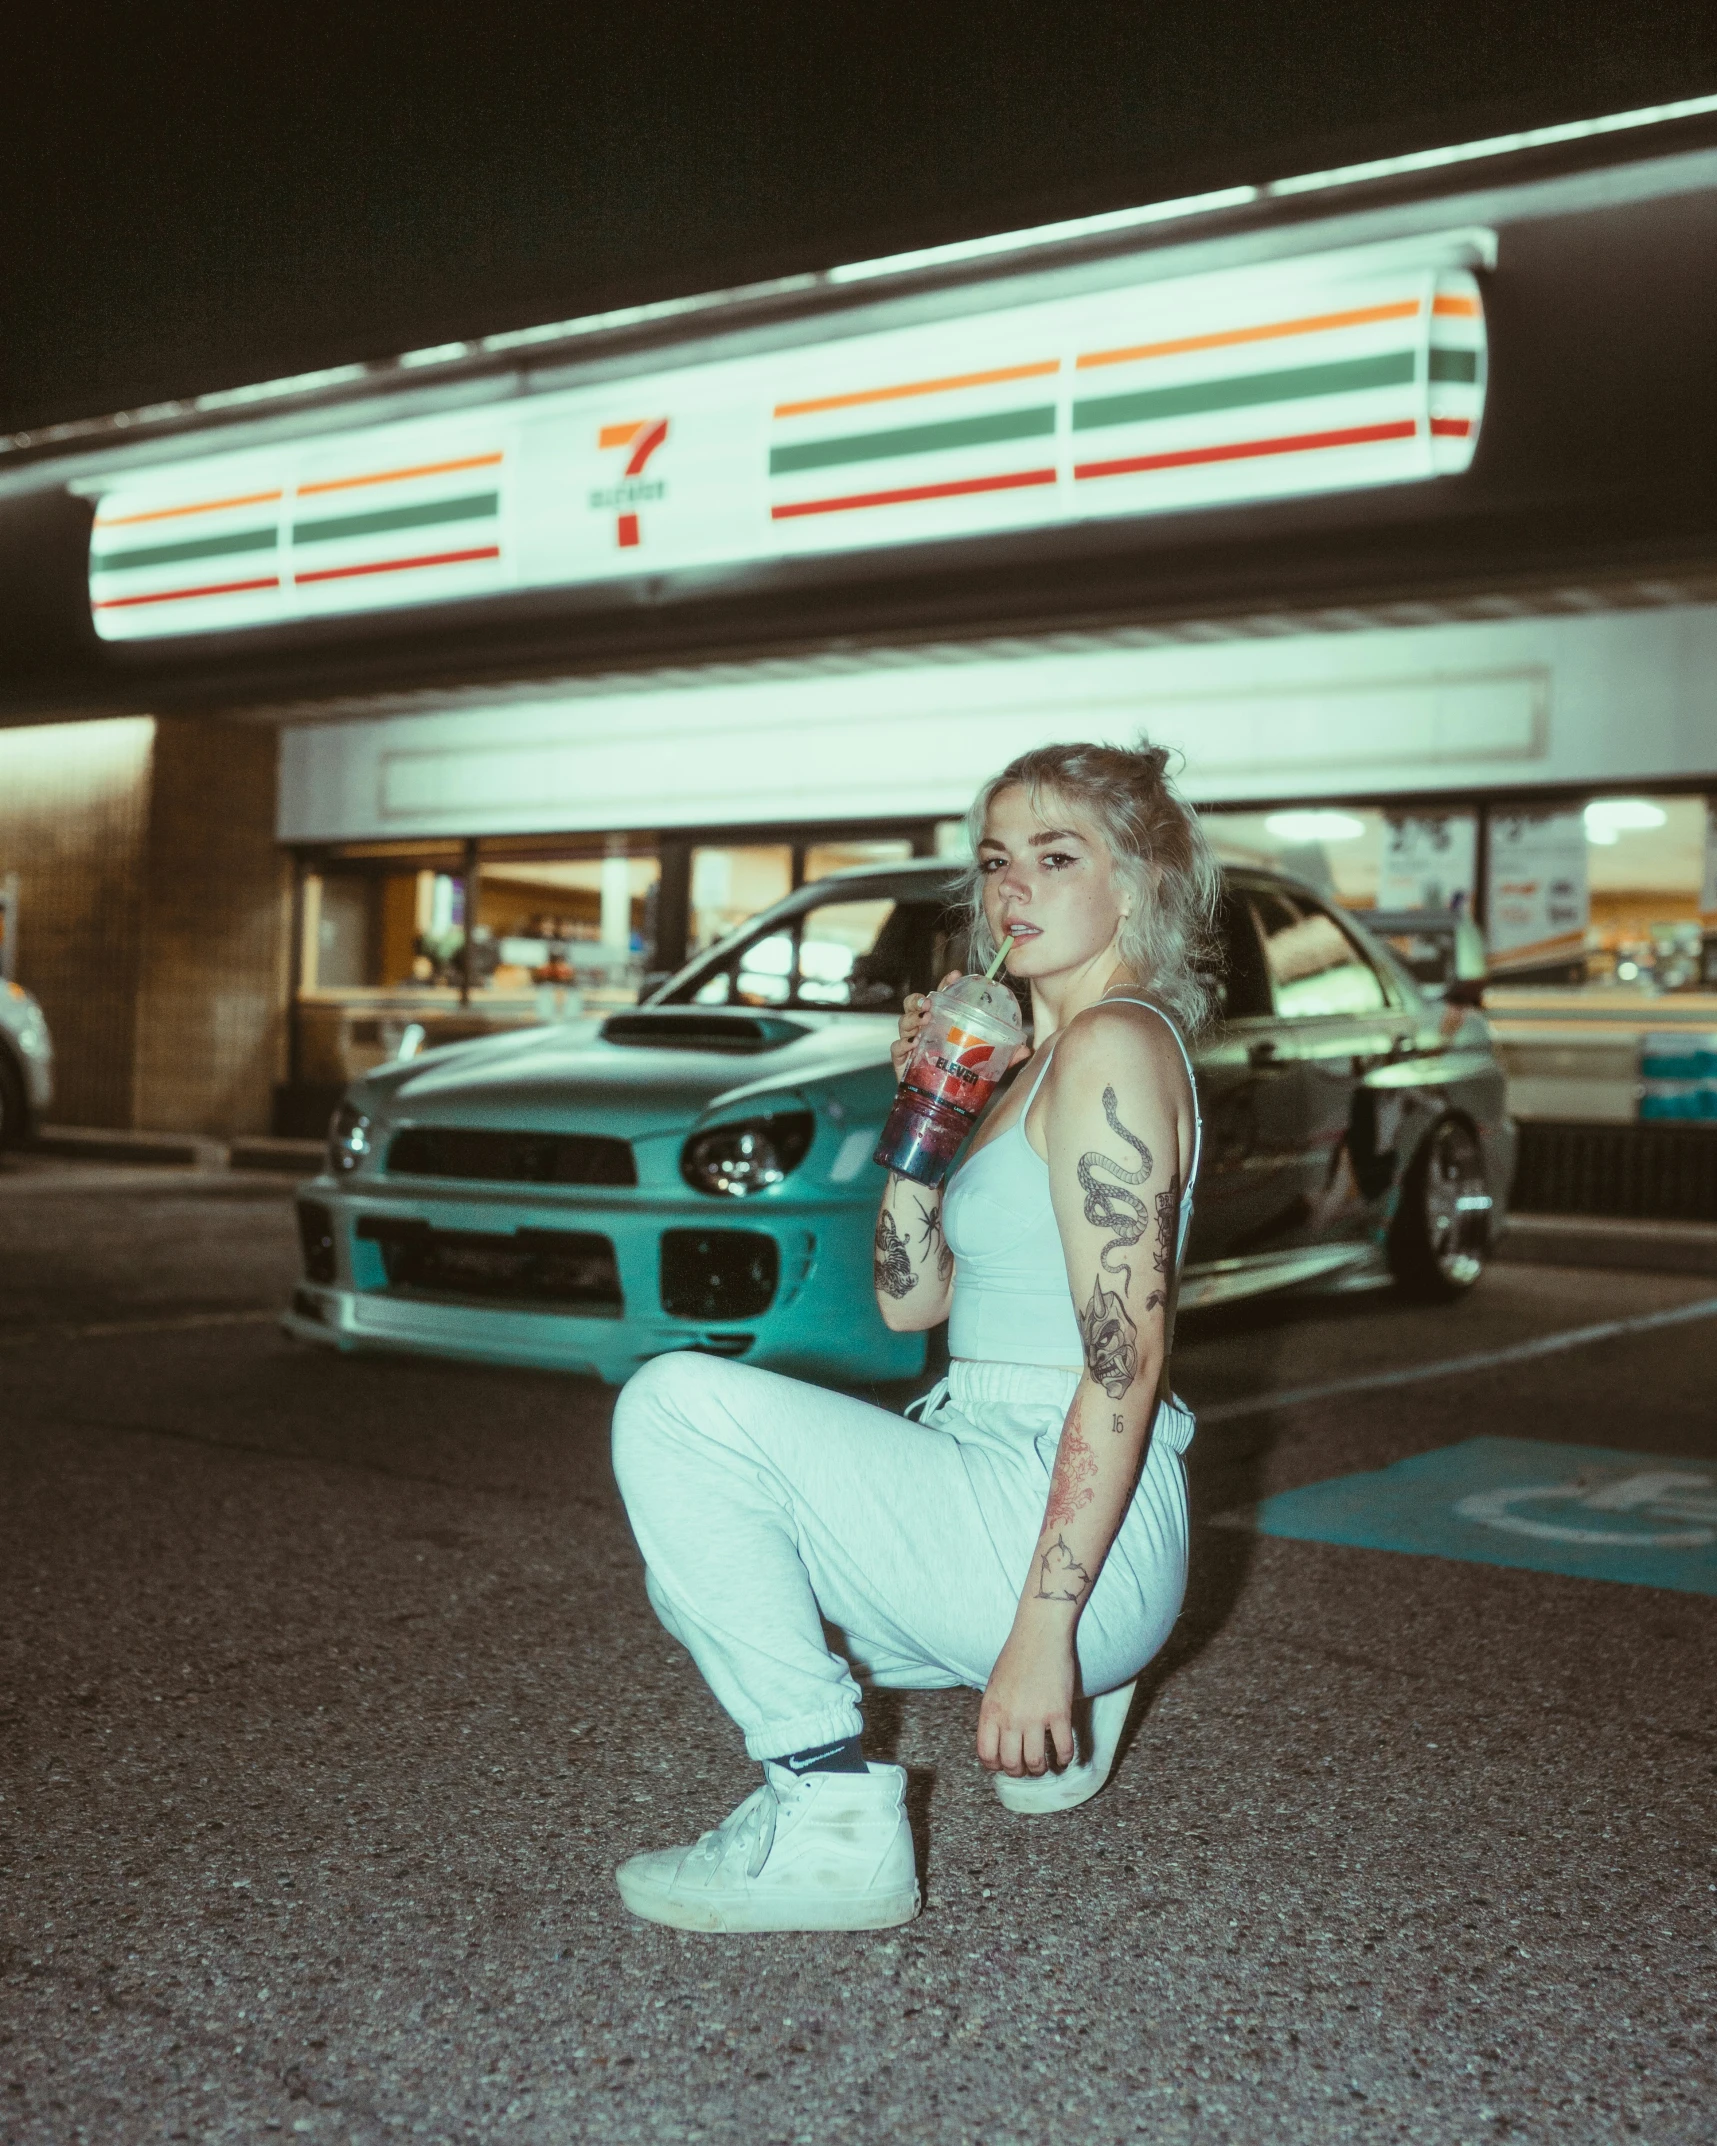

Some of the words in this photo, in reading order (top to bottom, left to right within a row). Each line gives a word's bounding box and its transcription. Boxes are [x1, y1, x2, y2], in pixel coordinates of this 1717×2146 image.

[598, 418, 669, 547] 7
[946, 1026, 995, 1096] 7
[1111, 1413, 1124, 1433] 16
